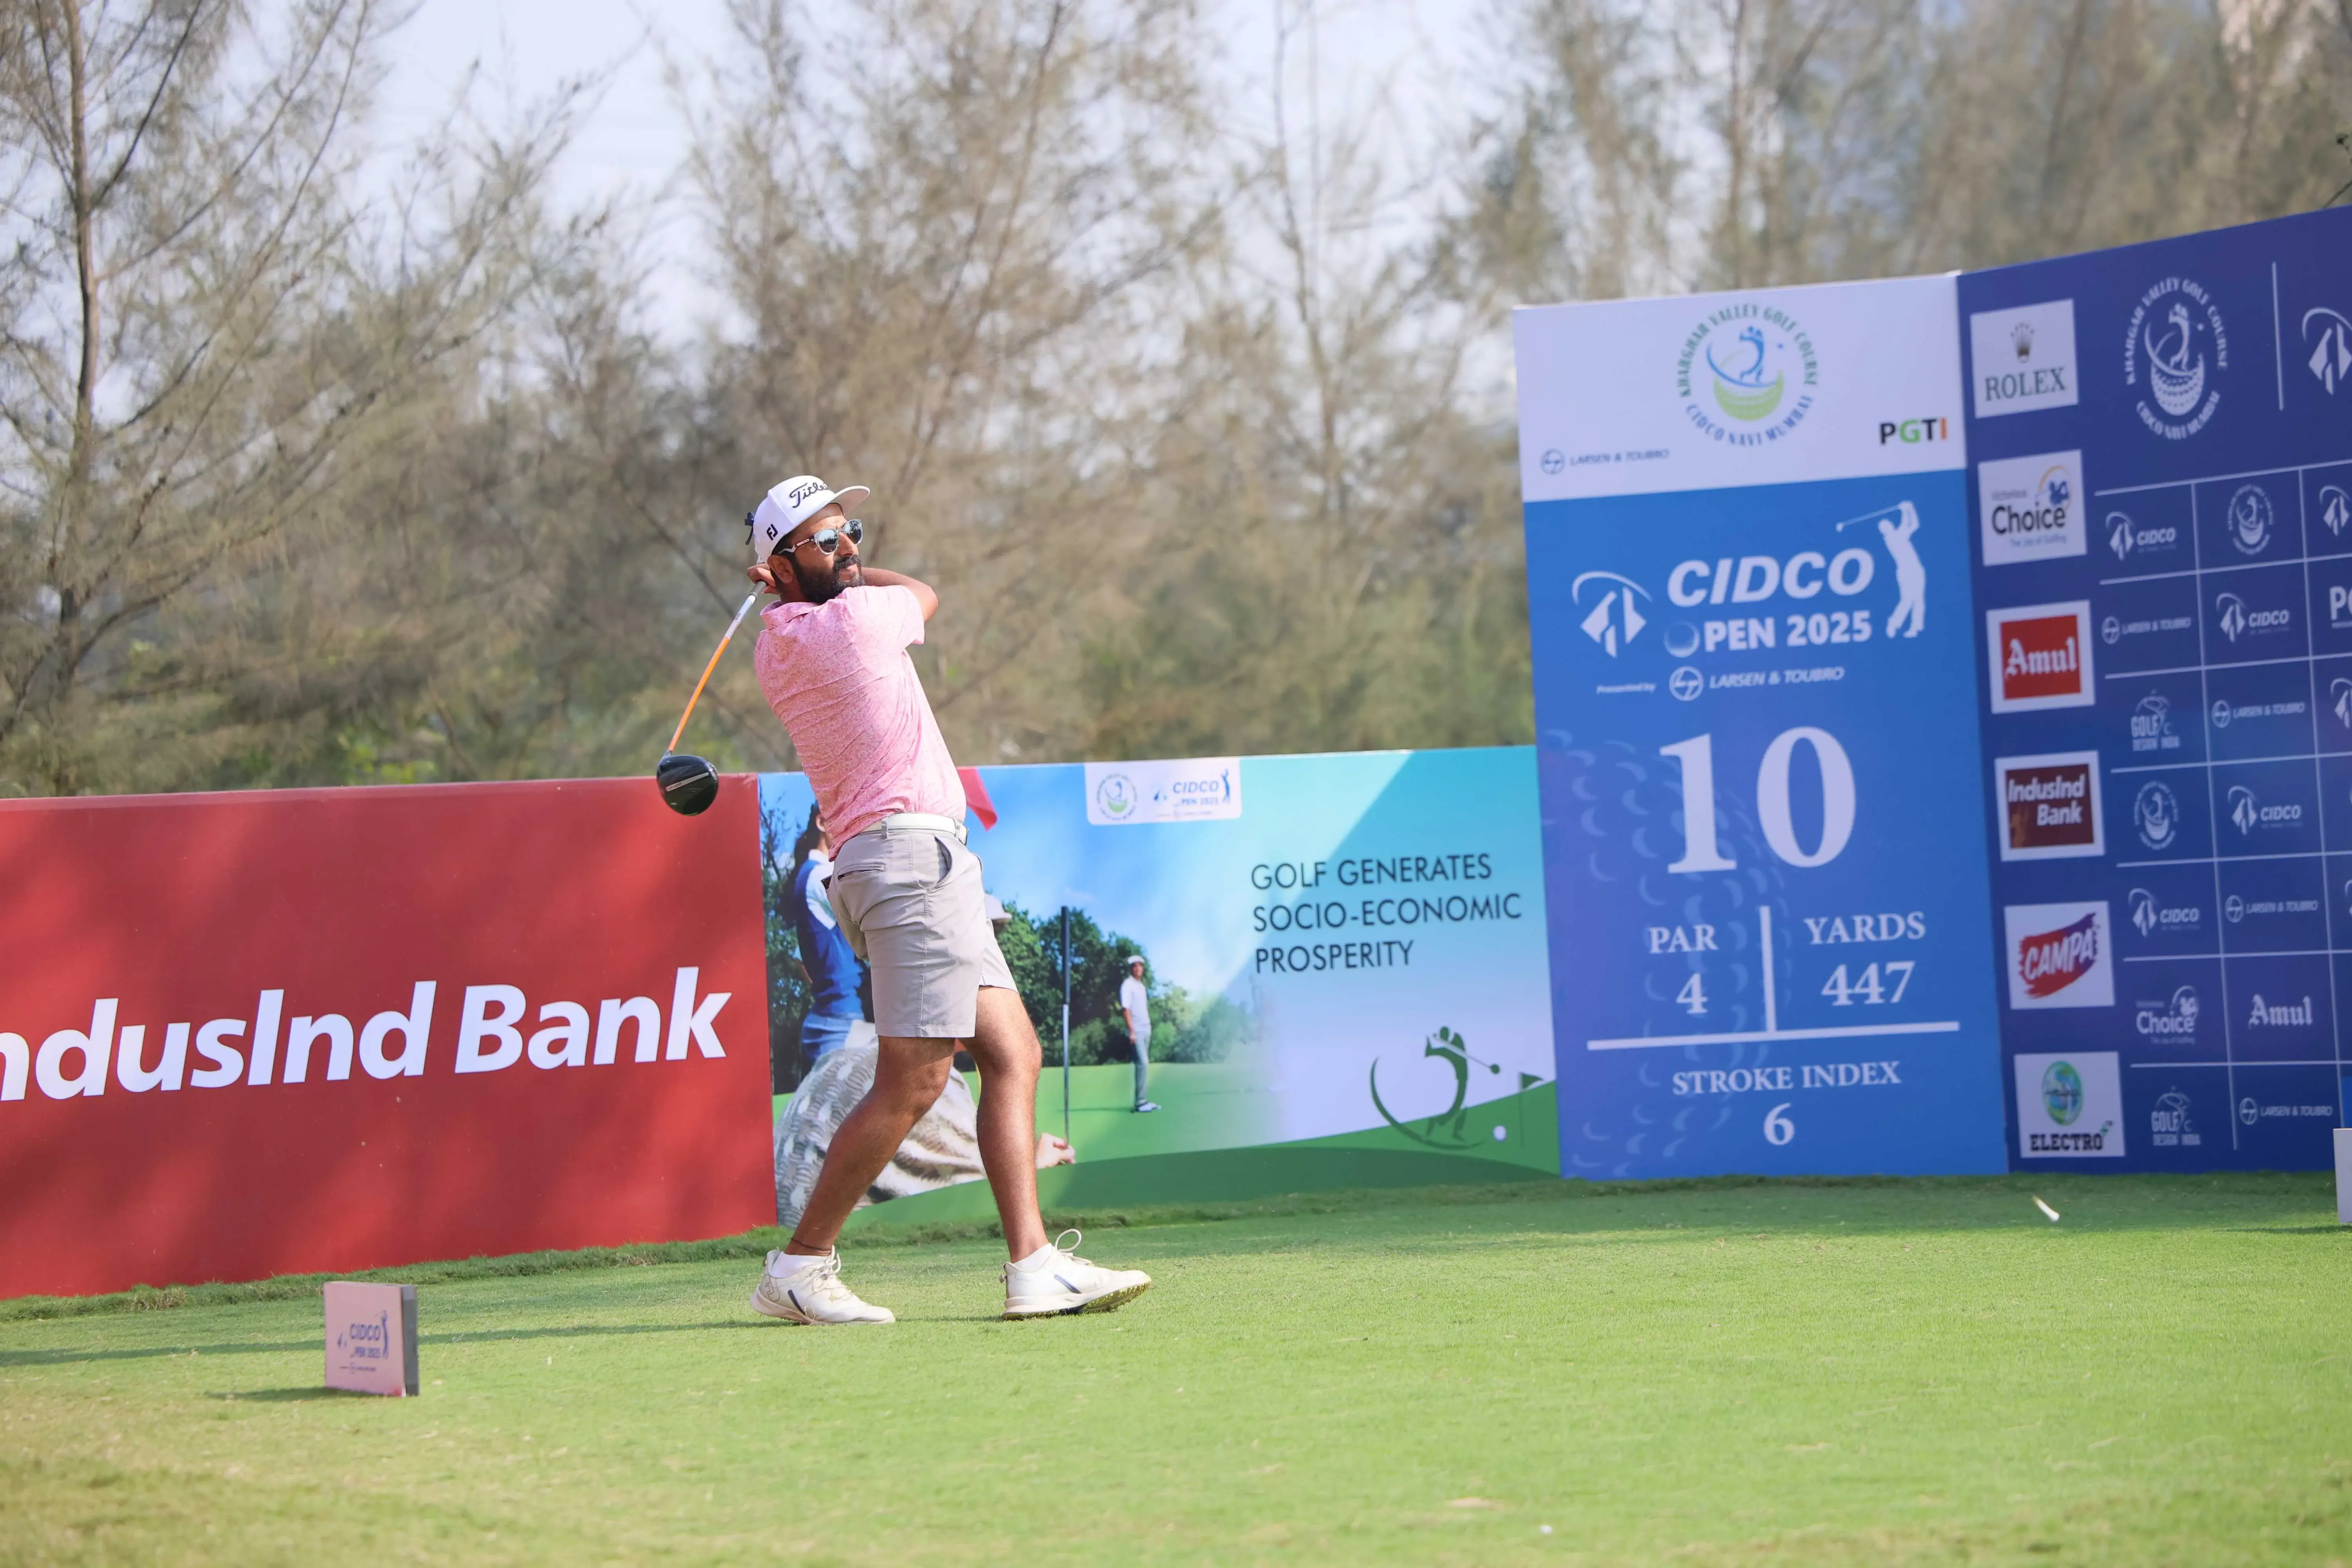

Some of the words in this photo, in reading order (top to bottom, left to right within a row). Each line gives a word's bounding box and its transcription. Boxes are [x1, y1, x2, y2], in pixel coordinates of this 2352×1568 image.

[1985, 367, 2066, 402] ROLEX
[1880, 417, 1947, 446] PGTI
[789, 482, 830, 508] Titlei
[1992, 502, 2065, 535] Choice
[2137, 528, 2176, 545] CIDCO
[1667, 548, 1875, 607] CIDCO
[1787, 610, 1872, 647] 2025
[2249, 610, 2289, 627] CIDCO
[2005, 636, 2077, 679] Amul
[1710, 671, 1765, 689] LARSEN
[1768, 671, 1780, 684] &
[1784, 666, 1845, 683] TOUBRO
[2131, 714, 2158, 737] GOLF
[1173, 780, 1219, 794] CIDCO
[1659, 726, 1856, 874] 10
[2009, 774, 2086, 802] IndusInd
[2037, 800, 2082, 826] Bank
[2261, 804, 2301, 821] CIDCO
[1252, 862, 1327, 889] GOLF
[1338, 853, 1492, 886] GENERATES
[1254, 893, 1522, 932] SOCIO-ECONOMIC
[1804, 911, 1925, 946] YARDS
[2160, 908, 2200, 923] CIDCO
[1648, 924, 1719, 954] PAR
[2024, 929, 2094, 980] CAMPA
[1256, 940, 1414, 974] PROSPERITY
[1676, 973, 1708, 1014] 4
[1821, 961, 1915, 1007] 447
[454, 966, 733, 1074] Bank
[2136, 1011, 2194, 1034] Choice
[2249, 994, 2312, 1028] Amul
[1672, 1066, 1793, 1096] STROKE
[1802, 1061, 1902, 1088] INDEX
[1763, 1102, 1795, 1145] 6
[2151, 1111, 2178, 1132] GOLF
[2030, 1133, 2103, 1151] ELECTRO
